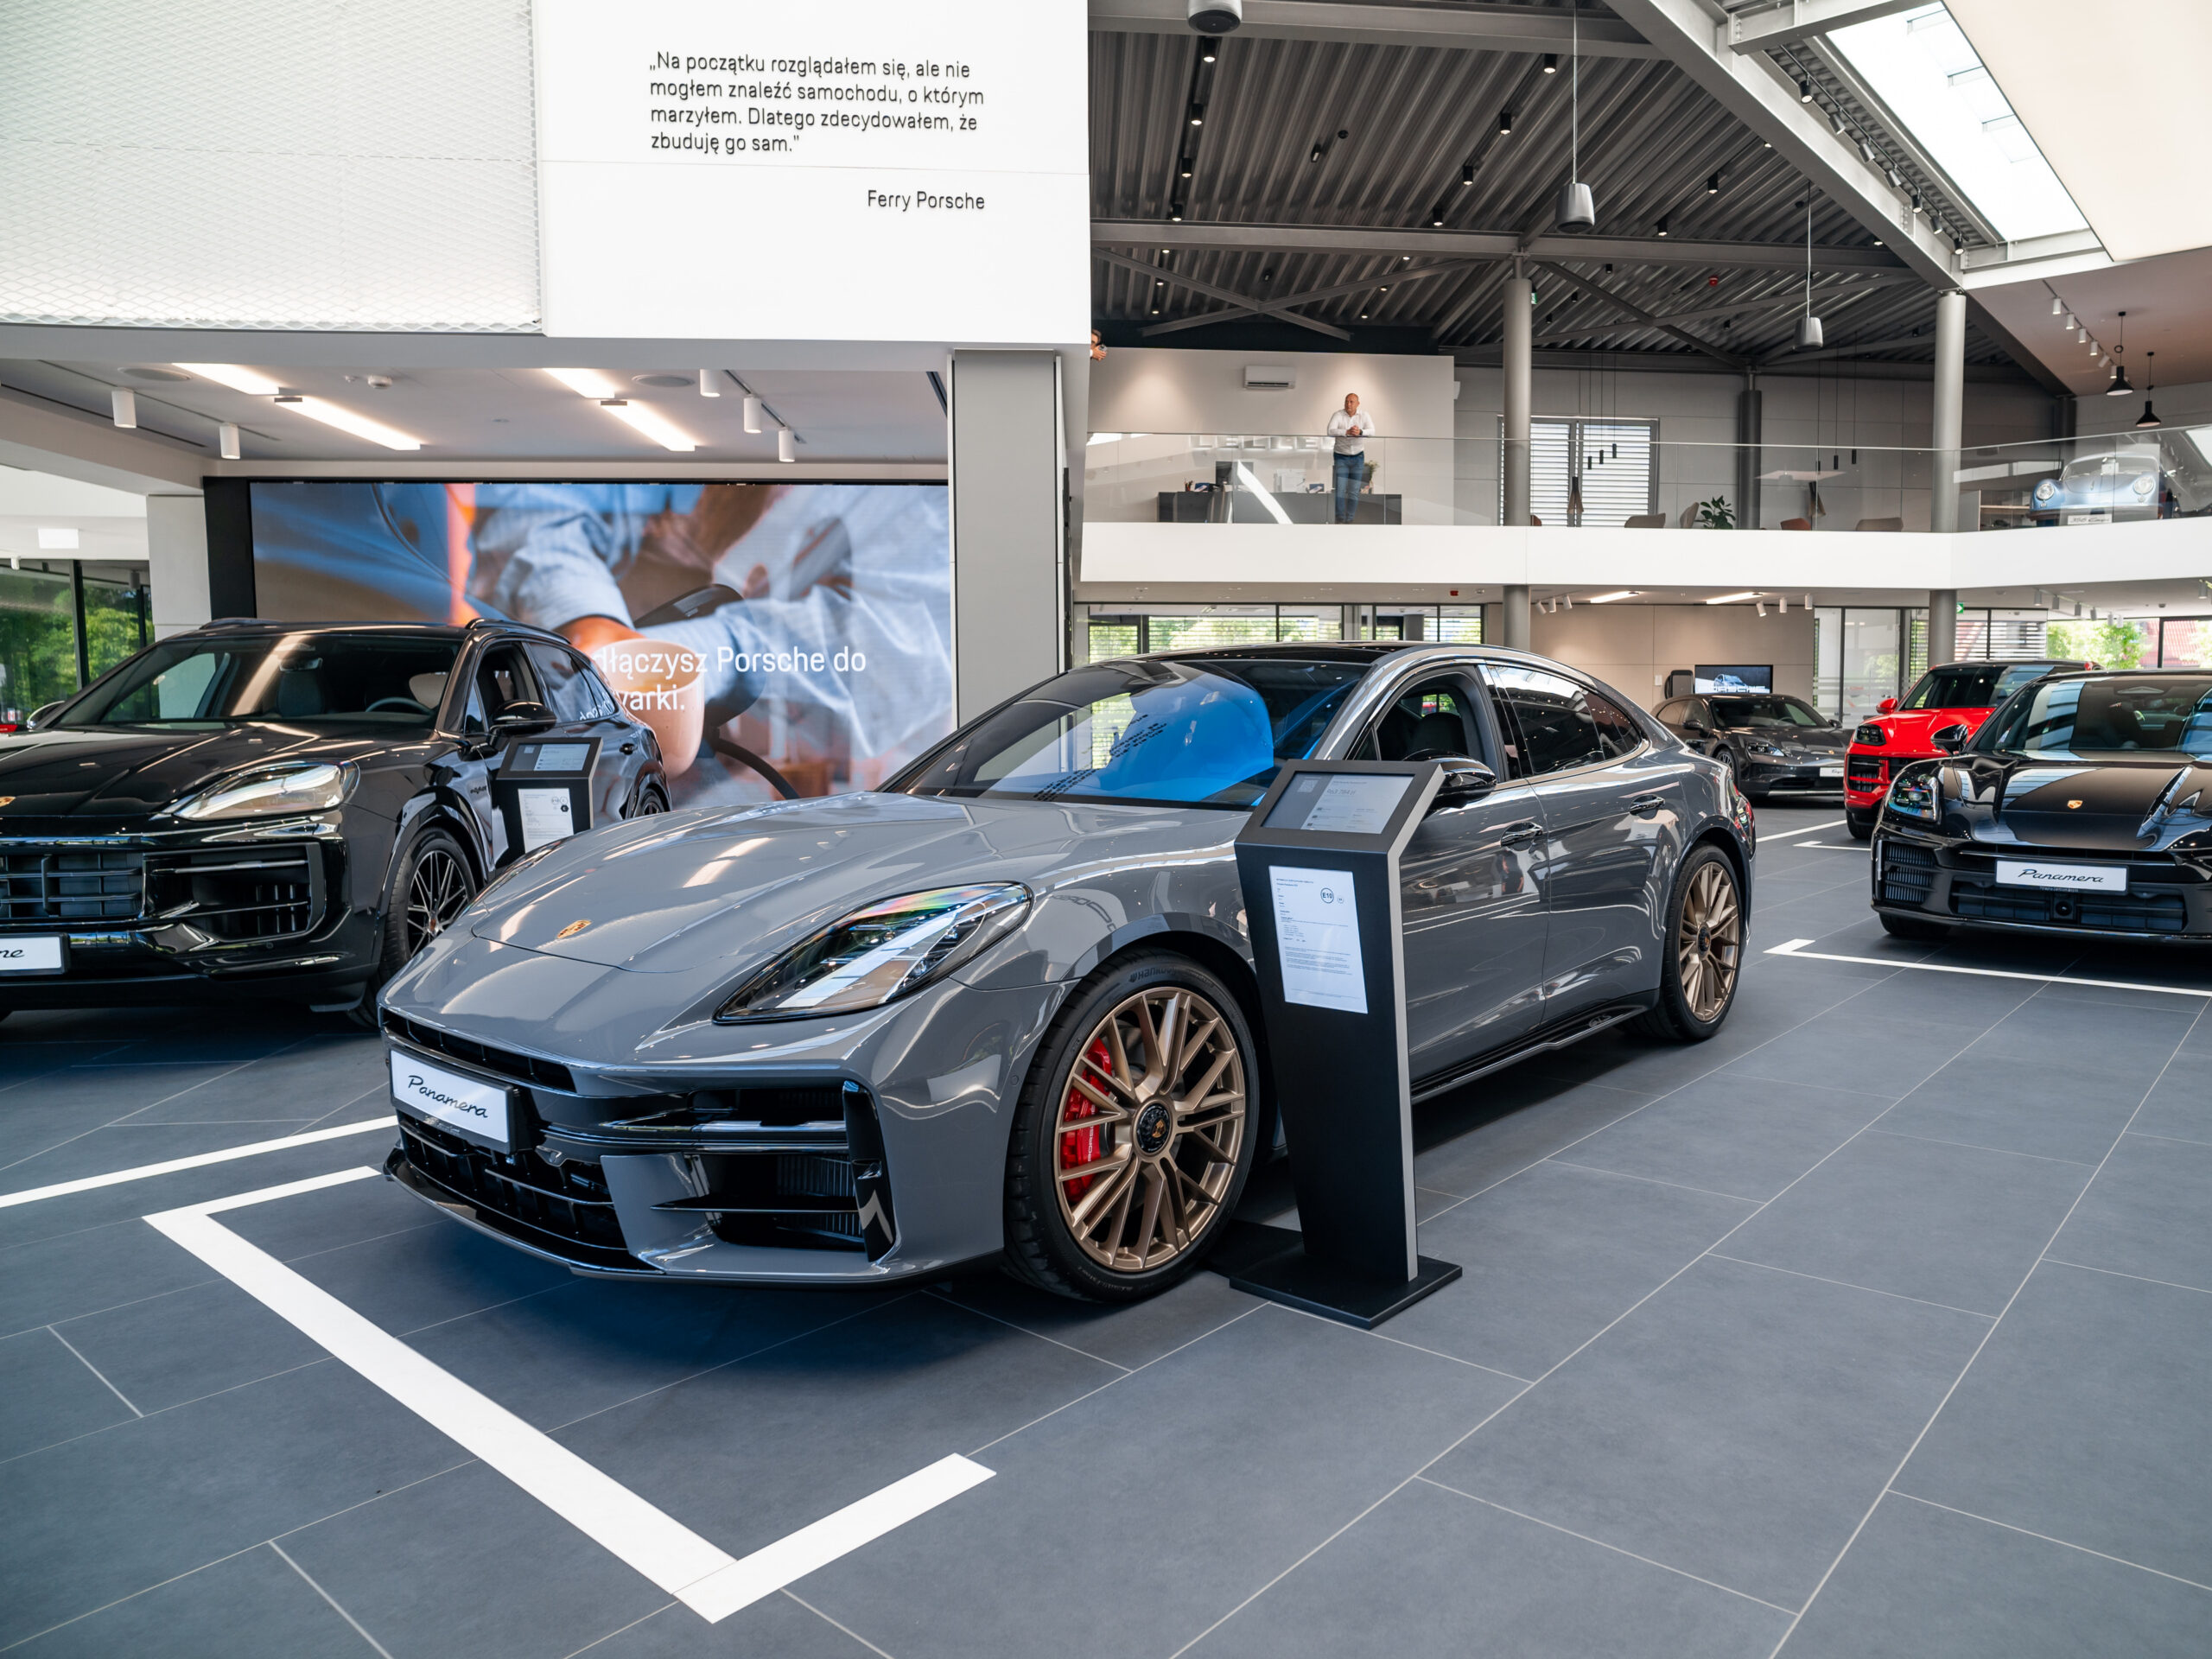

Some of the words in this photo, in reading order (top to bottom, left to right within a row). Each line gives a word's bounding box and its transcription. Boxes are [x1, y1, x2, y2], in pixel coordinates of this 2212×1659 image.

[687, 54, 765, 75] początku
[772, 56, 876, 78] rozglądałem
[883, 59, 910, 80] się,
[916, 60, 940, 78] ale
[946, 60, 970, 79] nie
[651, 79, 722, 101] mogłem
[728, 81, 791, 99] znaleźć
[798, 84, 902, 104] samochodu,
[908, 90, 918, 103] o
[924, 86, 984, 108] którym
[651, 106, 742, 127] marzyłem.
[749, 107, 815, 130] Dlatego
[821, 110, 954, 132] zdecydowałem,
[960, 112, 977, 130] że
[651, 132, 720, 154] zbuduję
[726, 138, 747, 155] go
[868, 189, 911, 212] Ferry
[917, 191, 985, 210] Porsche
[717, 646, 824, 672] Porsche
[834, 646, 866, 672] do
[2018, 868, 2105, 883] Panamera
[408, 1075, 488, 1118] Panamera
